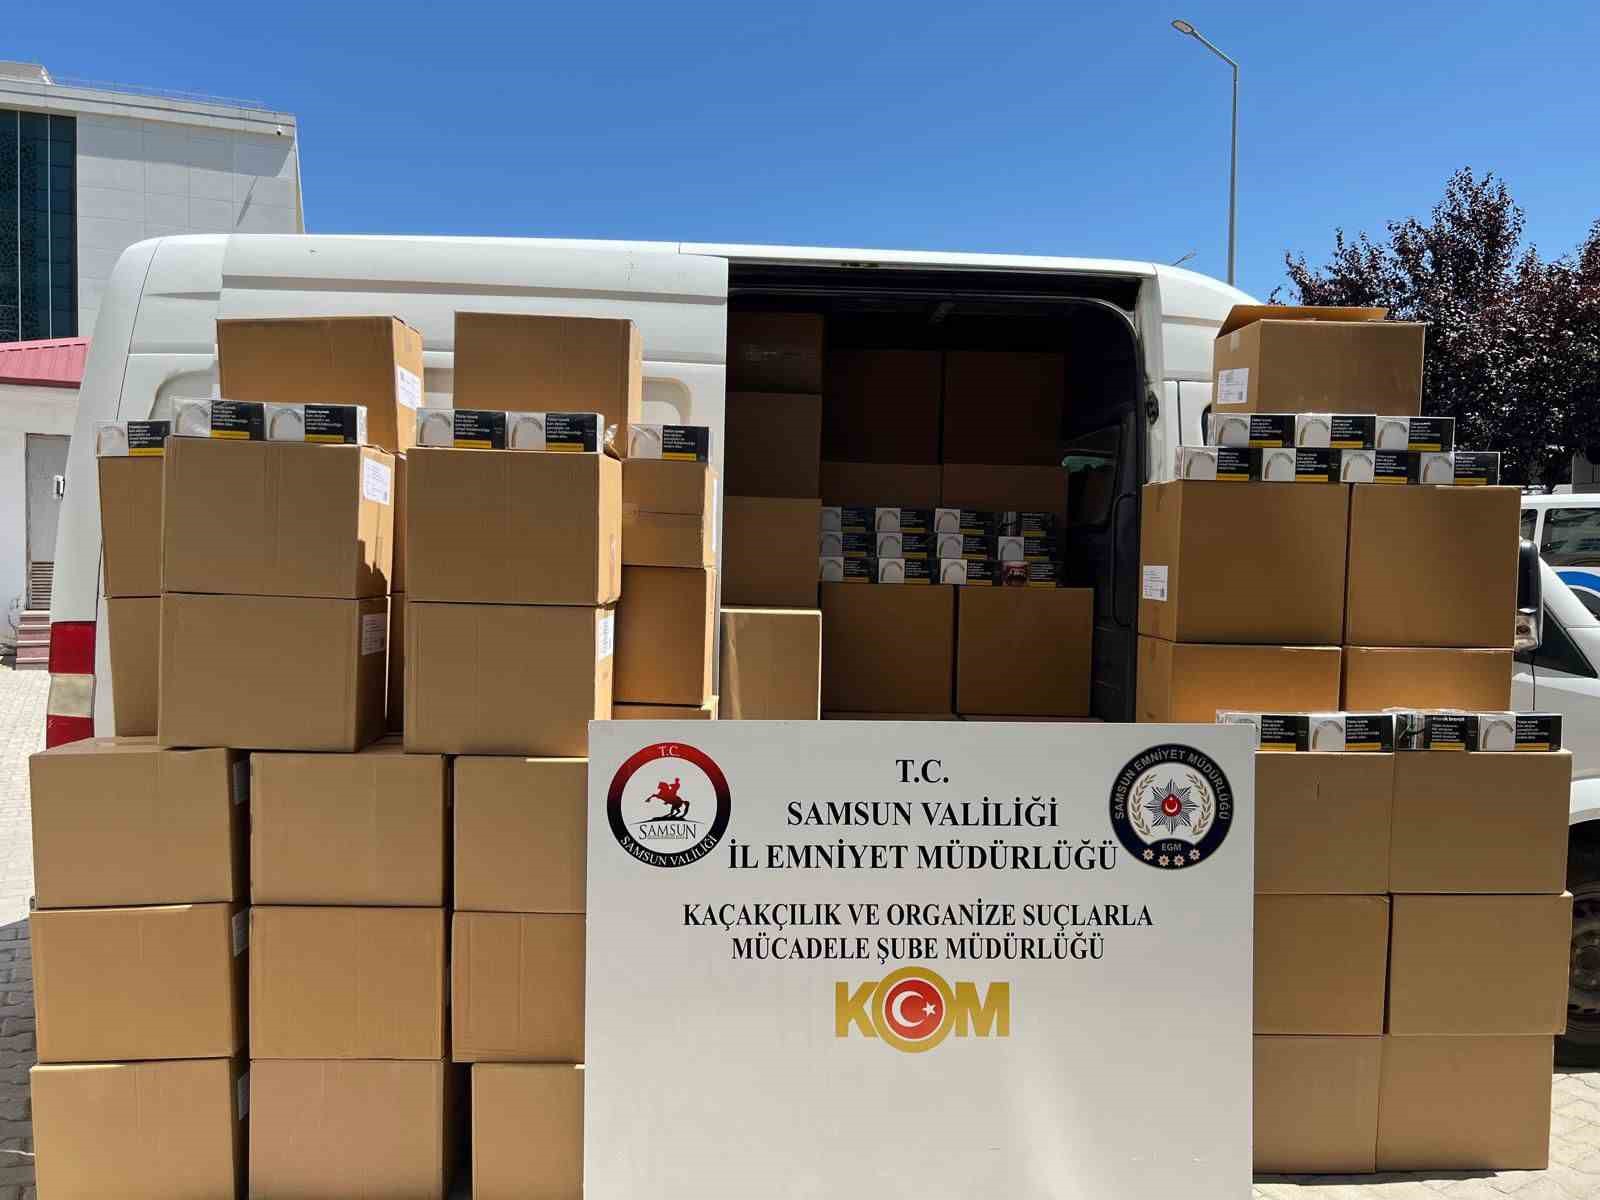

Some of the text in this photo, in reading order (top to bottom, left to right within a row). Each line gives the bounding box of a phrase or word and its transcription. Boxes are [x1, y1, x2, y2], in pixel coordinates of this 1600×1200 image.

[896, 759, 949, 784] T.C.
[1114, 748, 1231, 820] SAMSUN EMNİYET MÜDÜRLÜĞÜ
[787, 795, 1058, 827] SAMSUN VALİLİĞİ
[639, 823, 697, 840] SAMSUN
[1161, 842, 1183, 852] EGM
[620, 836, 667, 866] SAMSUN
[728, 837, 1119, 871] İL EMNİYET MÜDÜRLÜĞÜ
[684, 898, 1153, 932] KAÇAKÇILIK VE ORGANİZE SUÇLARLA
[732, 931, 1104, 965] MÜCADELE ŞUBE MÜDÜRLÜĞÜ
[835, 966, 1010, 1053] KOM
